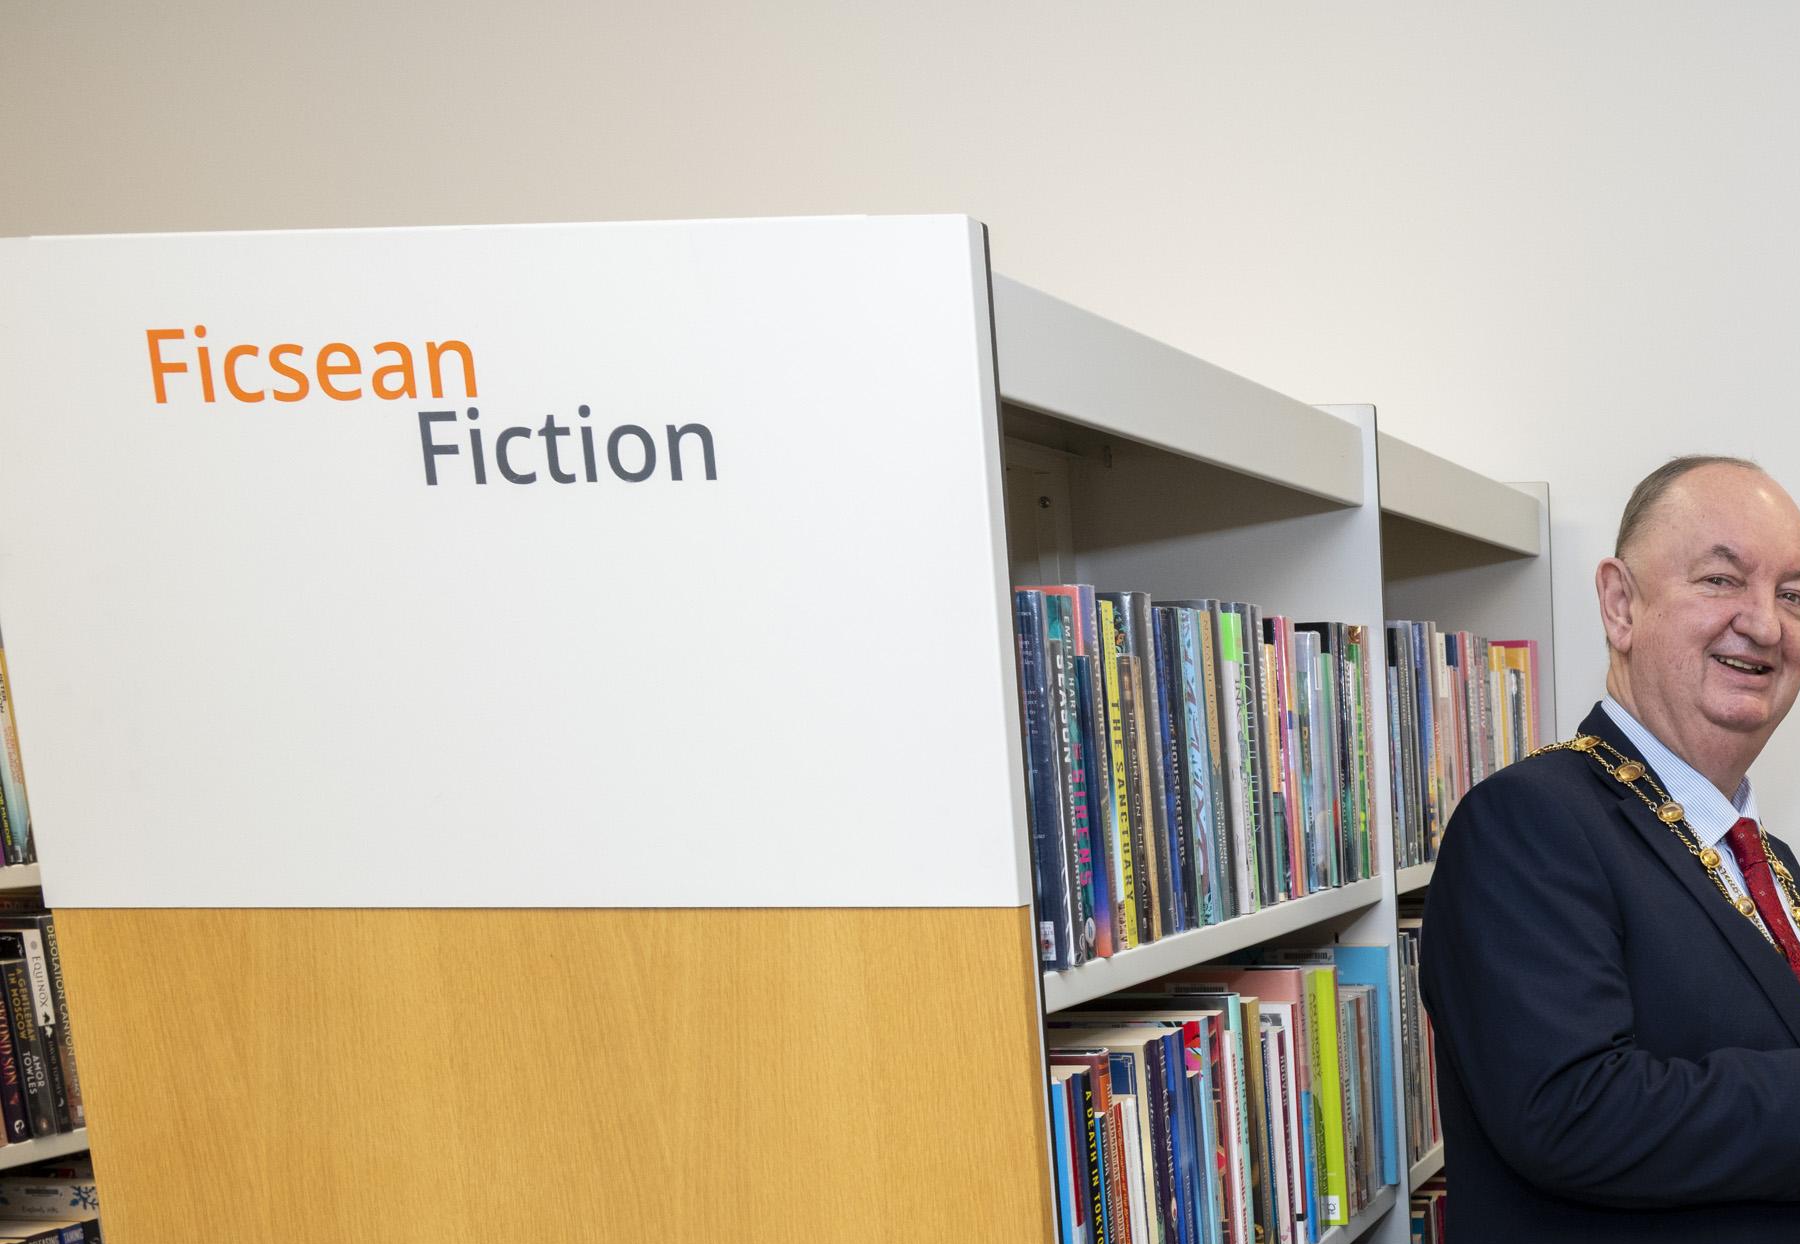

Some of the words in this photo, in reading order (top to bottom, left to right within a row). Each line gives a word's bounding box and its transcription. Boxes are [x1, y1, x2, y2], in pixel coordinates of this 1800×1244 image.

[145, 324, 477, 404] Ficsean
[419, 405, 716, 485] Fiction
[1064, 615, 1072, 670] EMILIA
[1, 808, 11, 846] MURDER
[1072, 769, 1092, 886] SIRENS
[1111, 700, 1121, 748] THE
[1116, 762, 1134, 901] SANCTUARY
[1171, 739, 1186, 867] HOUSEKEEPERS
[1068, 774, 1076, 839] GEORGE
[1074, 843, 1082, 921] HARRISON
[8, 973, 17, 983] IN
[31, 956, 48, 1008] EQUINOX
[46, 925, 65, 999] DESOLATION
[59, 1004, 74, 1056] CANYON
[11, 989, 28, 1040] MOSCOW
[17, 979, 36, 1041] GENTLEMAN
[3, 1059, 16, 1085] SON
[23, 1051, 37, 1094] TOWLES
[32, 1056, 44, 1087] AMOR
[1085, 1090, 1091, 1100] A
[1232, 1054, 1242, 1145] motherthing
[1087, 1108, 1096, 1162] DEATH
[1163, 1088, 1175, 1191] KNOWING
[1092, 1169, 1099, 1185] IN
[63, 1228, 84, 1243] TAMING
